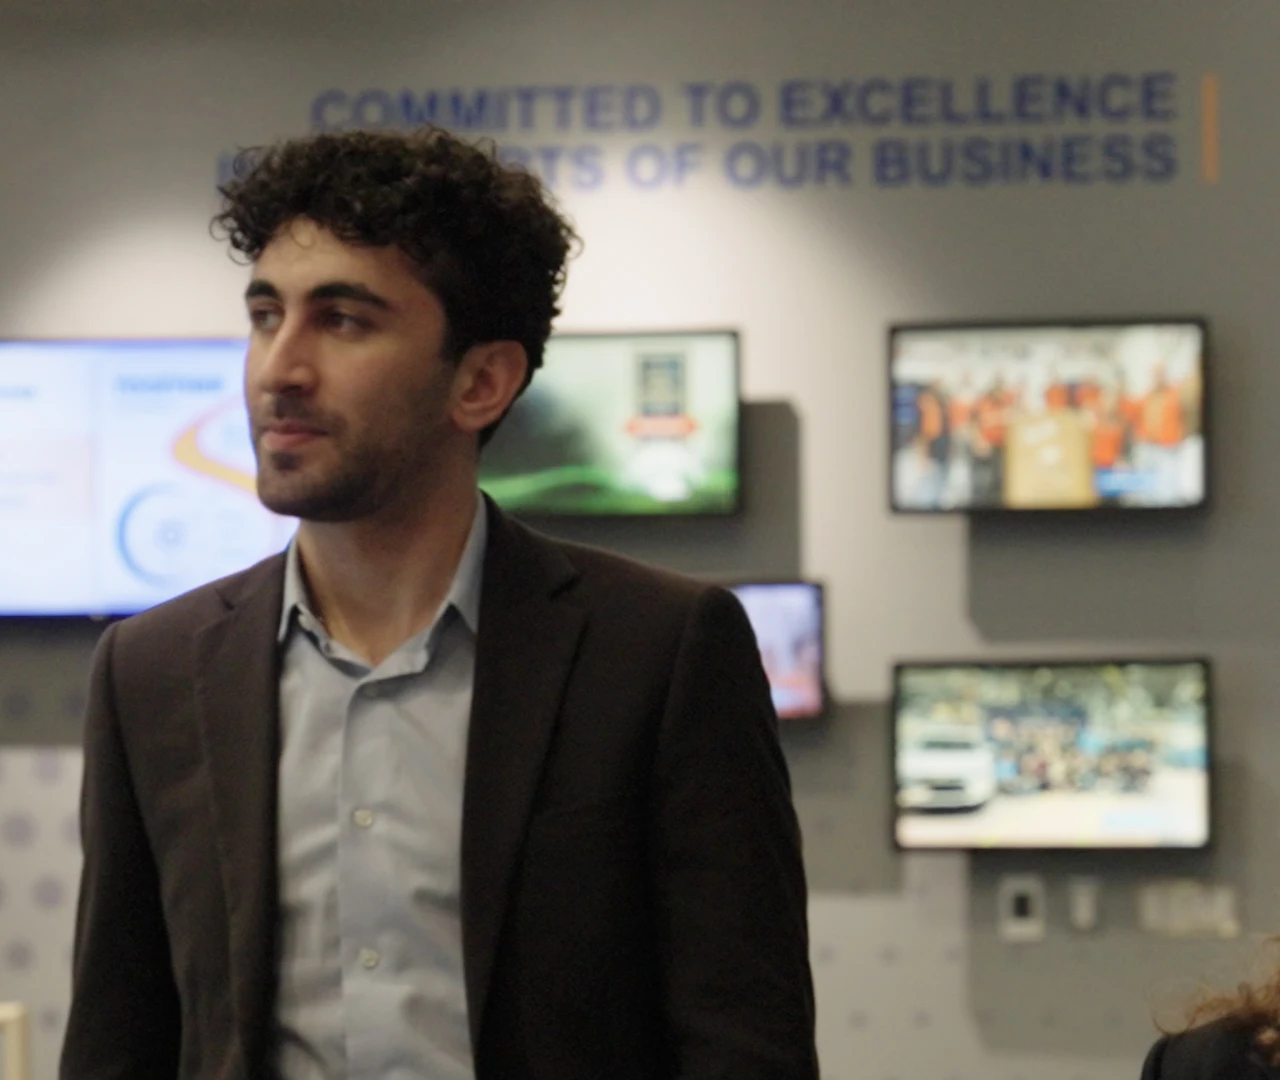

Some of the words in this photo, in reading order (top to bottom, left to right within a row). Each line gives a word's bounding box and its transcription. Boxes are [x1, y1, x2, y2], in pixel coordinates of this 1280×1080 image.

[311, 85, 662, 132] COMMITTED
[682, 79, 762, 130] TO
[778, 72, 1178, 129] EXCELLENCE
[624, 143, 701, 190] OF
[724, 139, 852, 188] OUR
[873, 132, 1178, 187] BUSINESS
